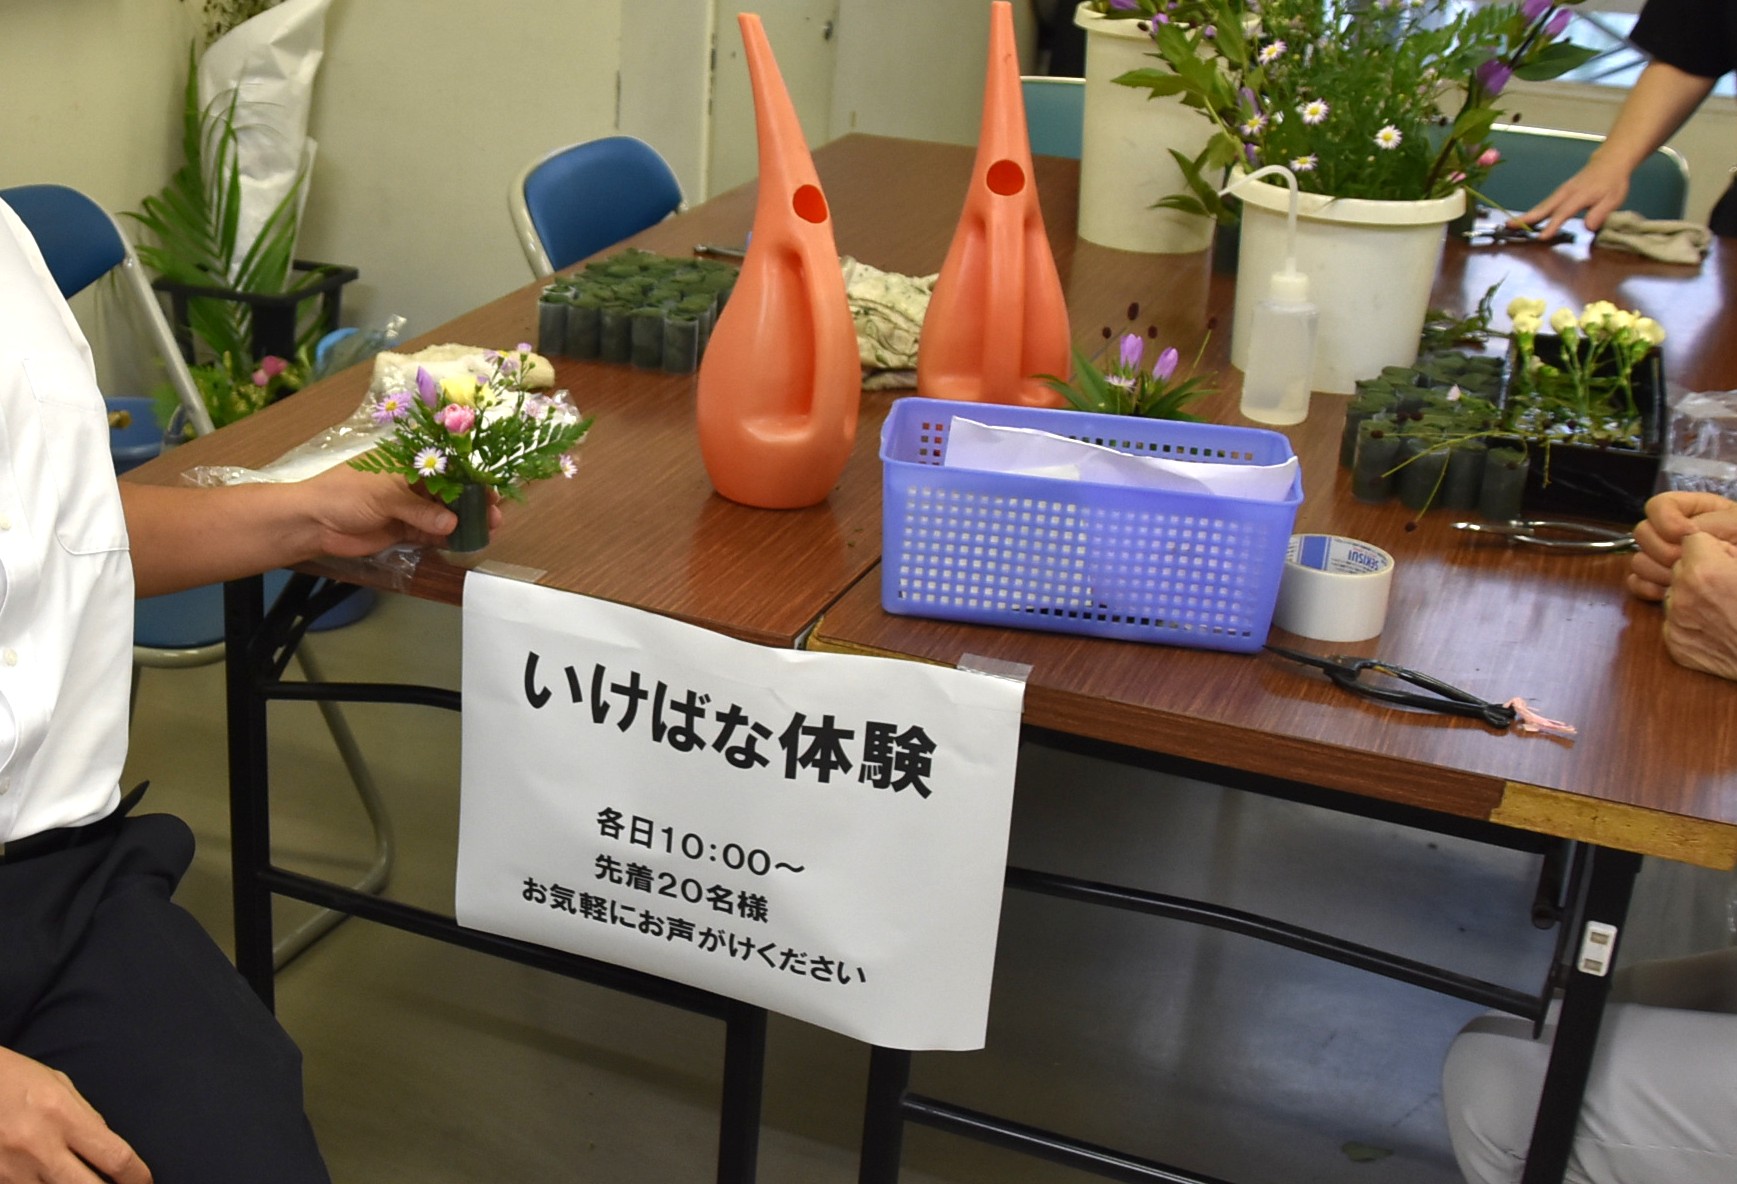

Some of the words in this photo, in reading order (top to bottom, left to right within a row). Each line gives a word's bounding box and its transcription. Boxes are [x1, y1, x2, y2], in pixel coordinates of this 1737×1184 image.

[1347, 550, 1380, 570] SEKISUI
[523, 651, 938, 800] いけばな体験
[521, 876, 867, 986] お気軽にお声がけください
[594, 853, 769, 924] 先着20名様
